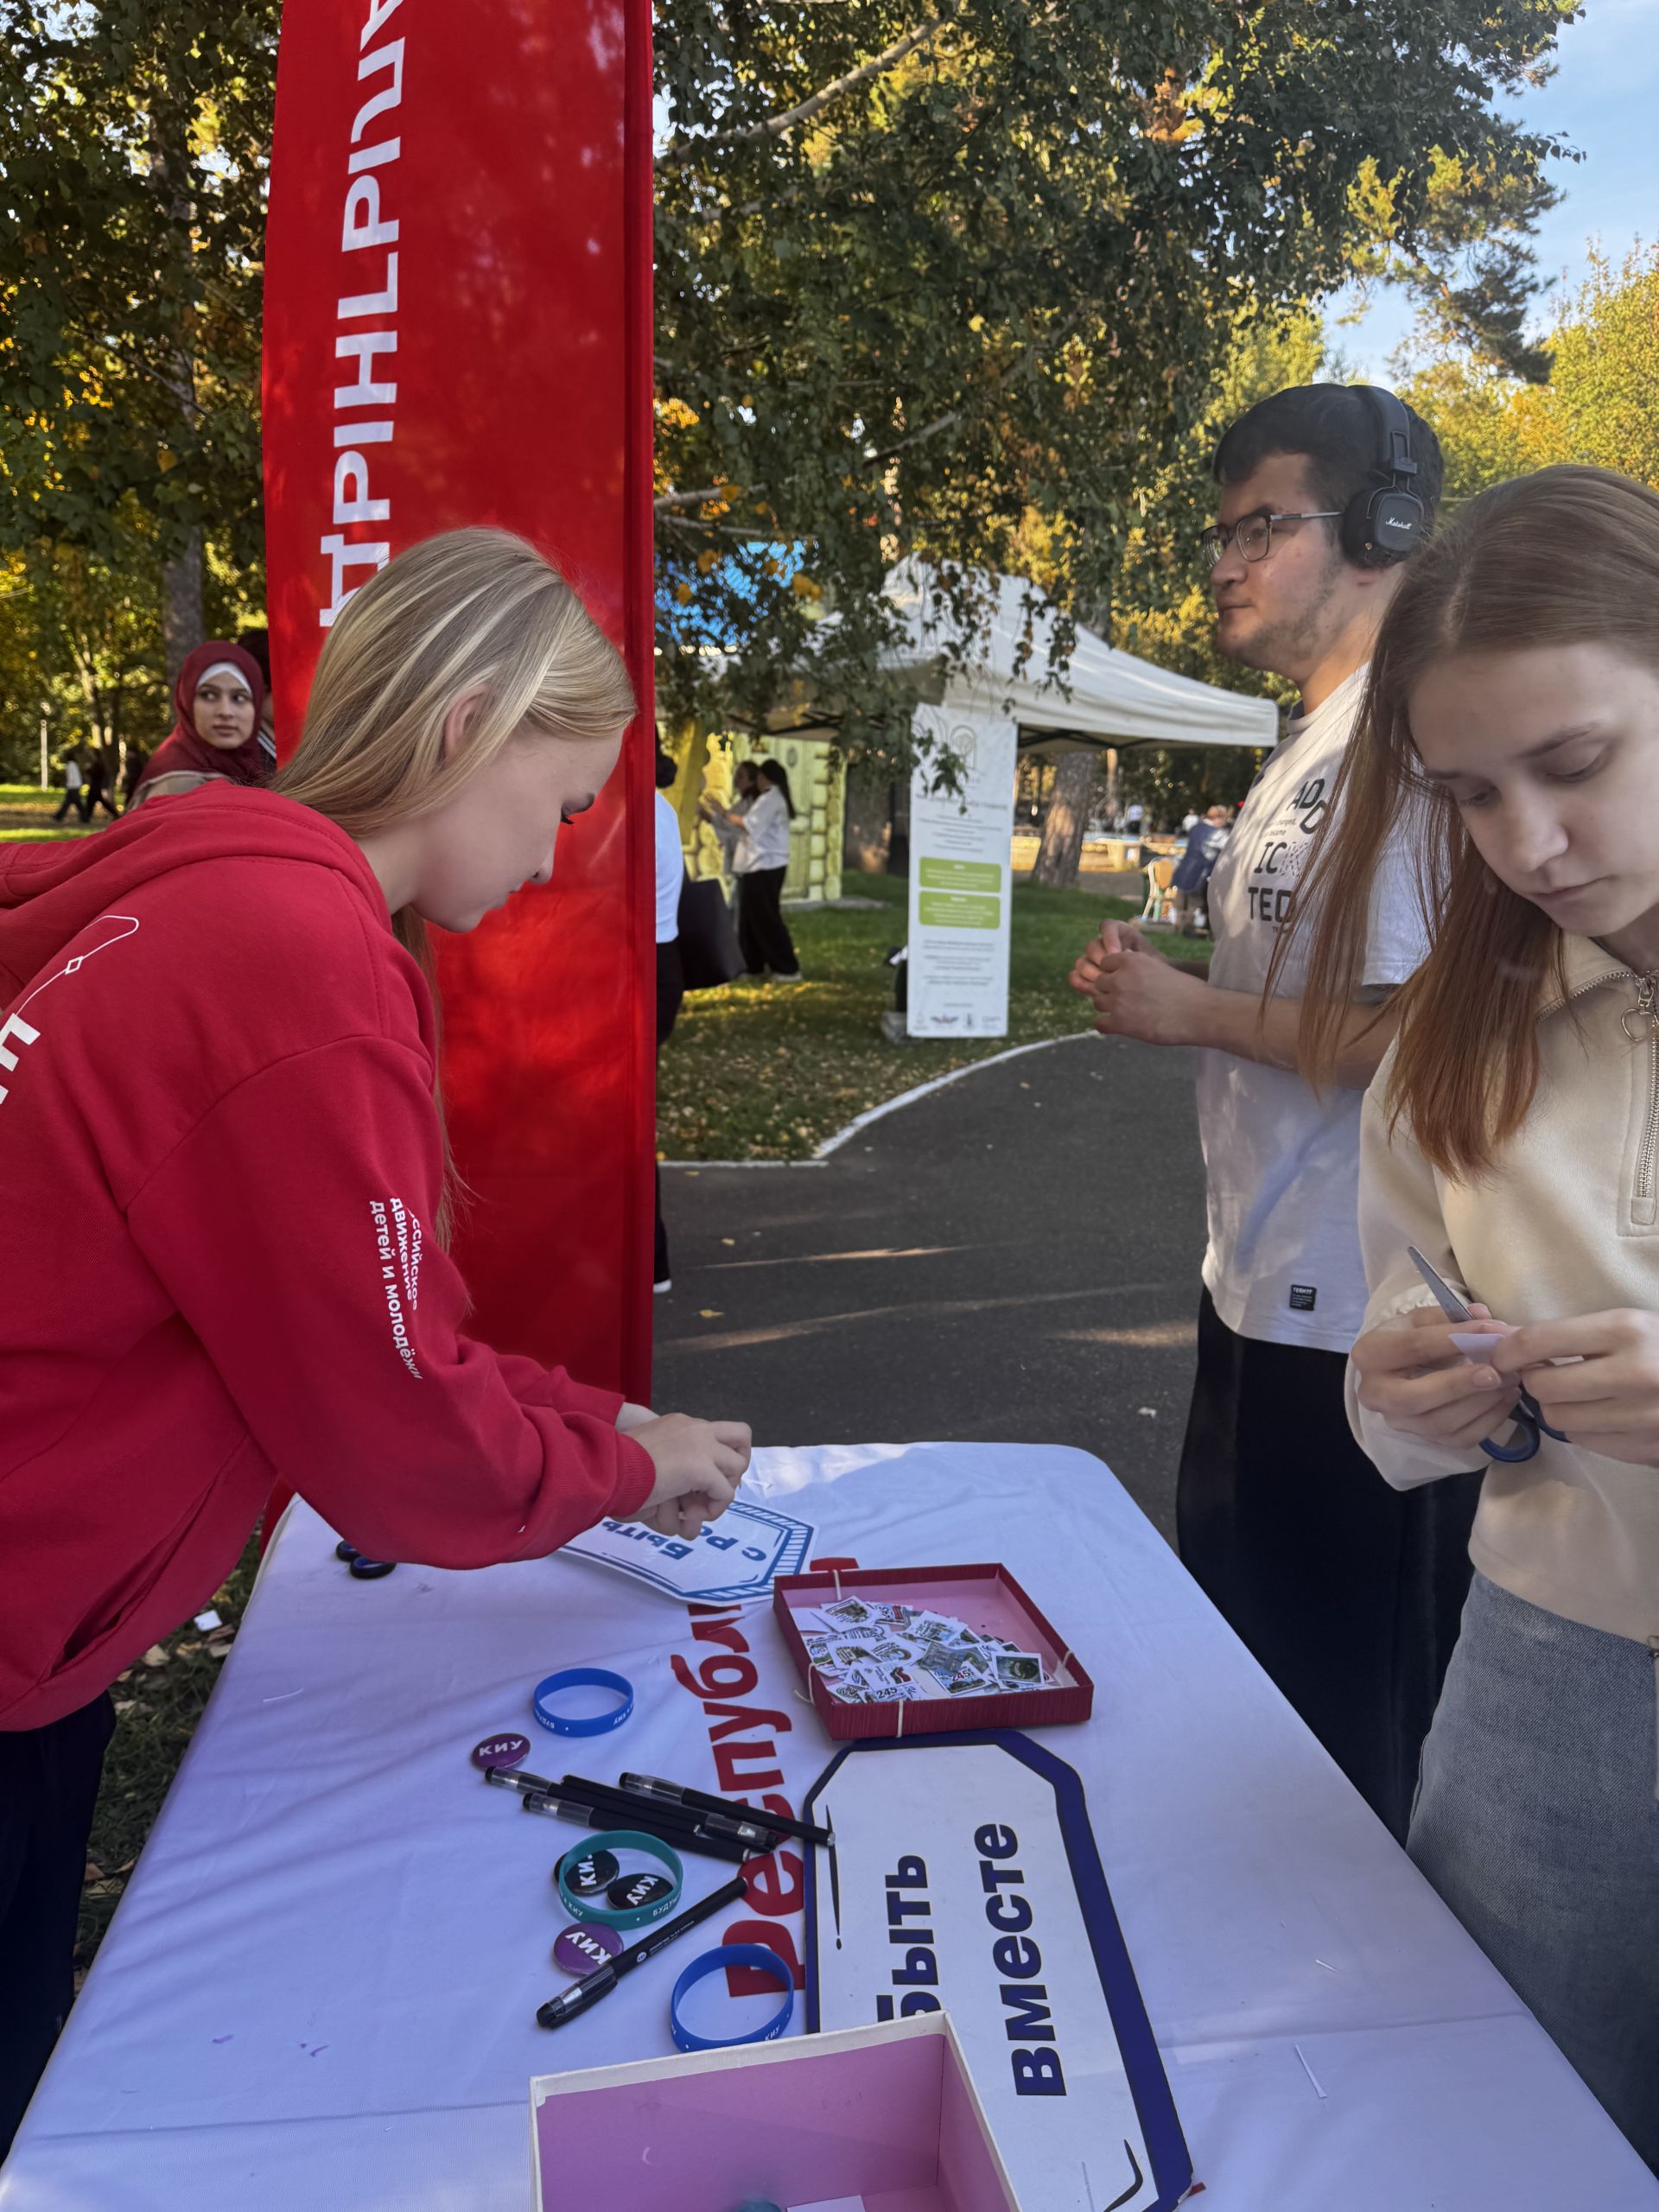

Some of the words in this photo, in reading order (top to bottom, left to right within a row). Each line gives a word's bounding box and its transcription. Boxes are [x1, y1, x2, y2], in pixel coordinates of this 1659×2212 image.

[370, 1200, 396, 1260] детей
[383, 1265, 395, 1279] и
[408, 1207, 423, 1311] ссийское
[385, 1284, 423, 1380] молодёжи
[601, 1520, 694, 1560] Быть
[876, 1687, 898, 1700] 245
[479, 1739, 524, 1757] КИУ
[577, 1854, 597, 1886] КИ
[626, 1875, 658, 1906] КИУ
[565, 1930, 613, 1966] КИУ
[974, 1823, 1067, 2097] вместе
